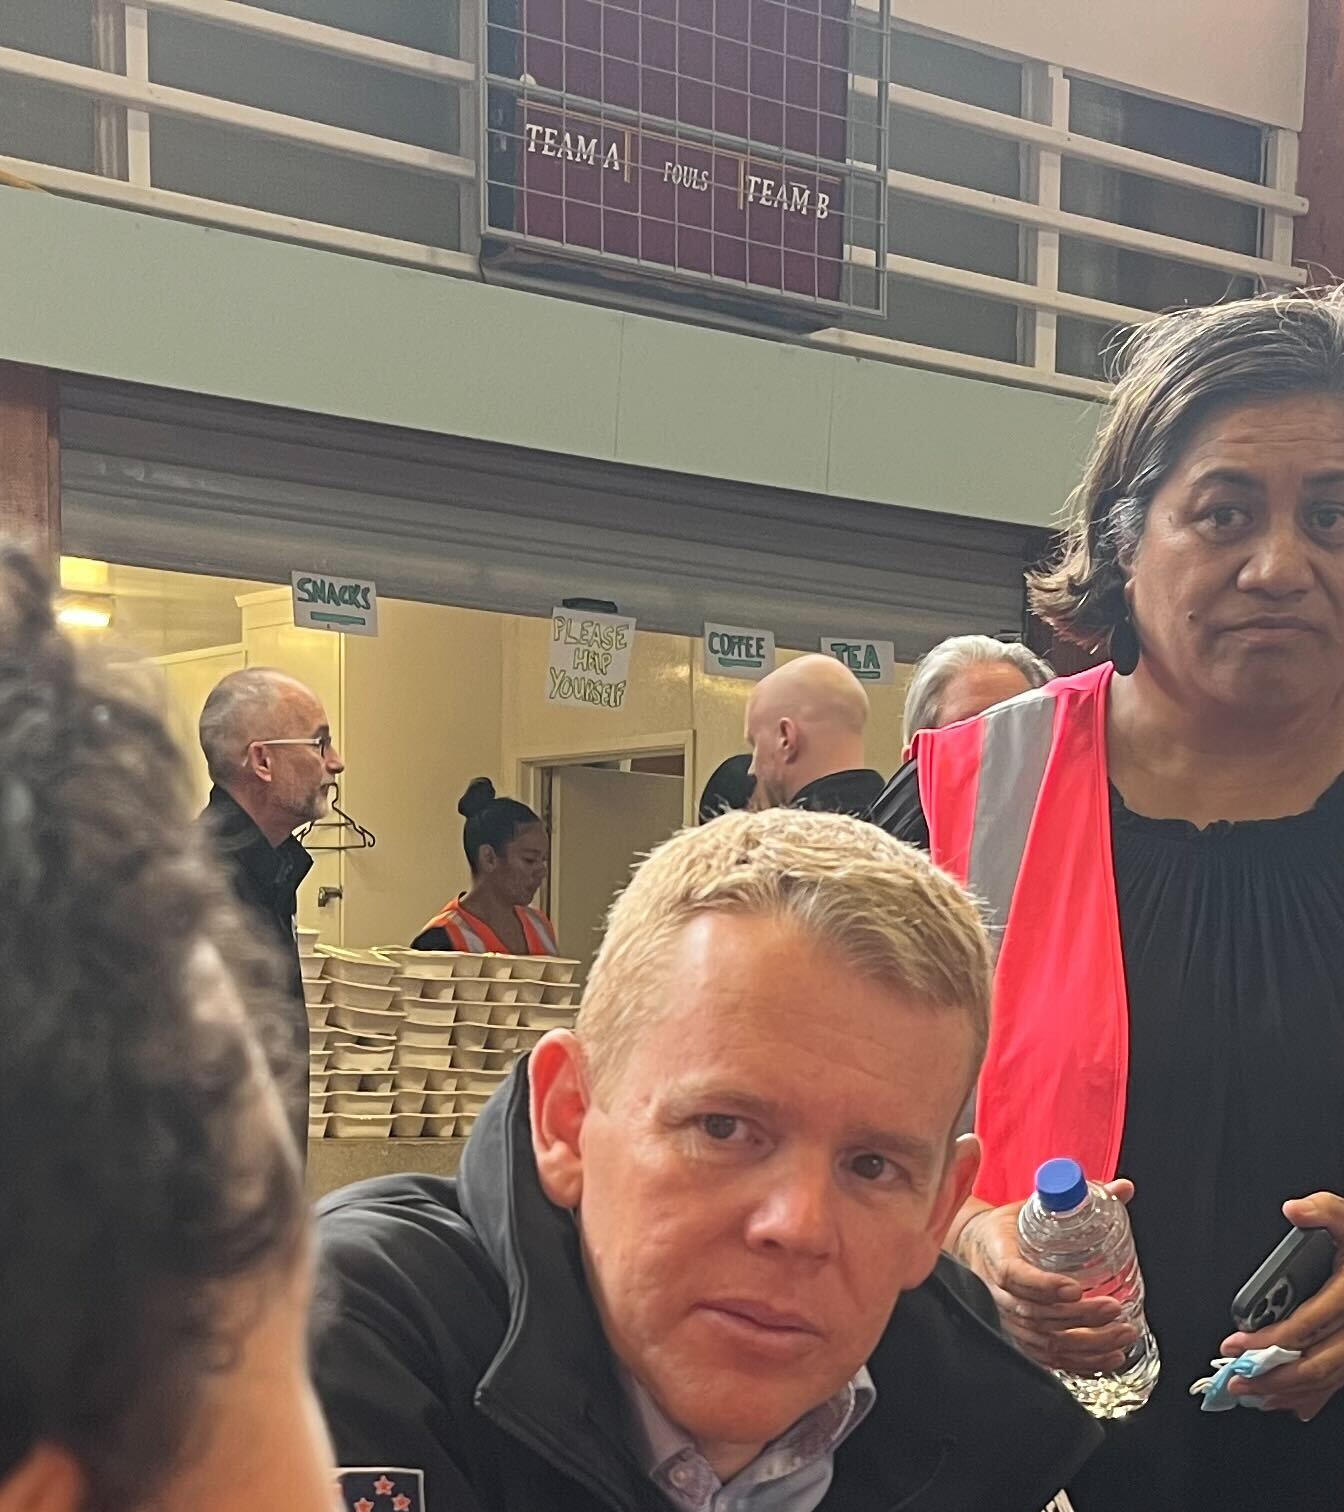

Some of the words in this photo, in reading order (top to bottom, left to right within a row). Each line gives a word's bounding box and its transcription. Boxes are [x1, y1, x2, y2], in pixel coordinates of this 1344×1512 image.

[526, 123, 598, 166] TEAM
[602, 142, 620, 171] A
[663, 161, 709, 192] FOULS
[746, 175, 811, 216] TEAM
[816, 192, 830, 220] B
[297, 577, 371, 610] SNACKS
[553, 616, 630, 651] PLEASE
[708, 631, 766, 660] COFFEE
[573, 647, 613, 676] HELP
[830, 643, 881, 670] TEA
[549, 666, 627, 708] YOURSELF
